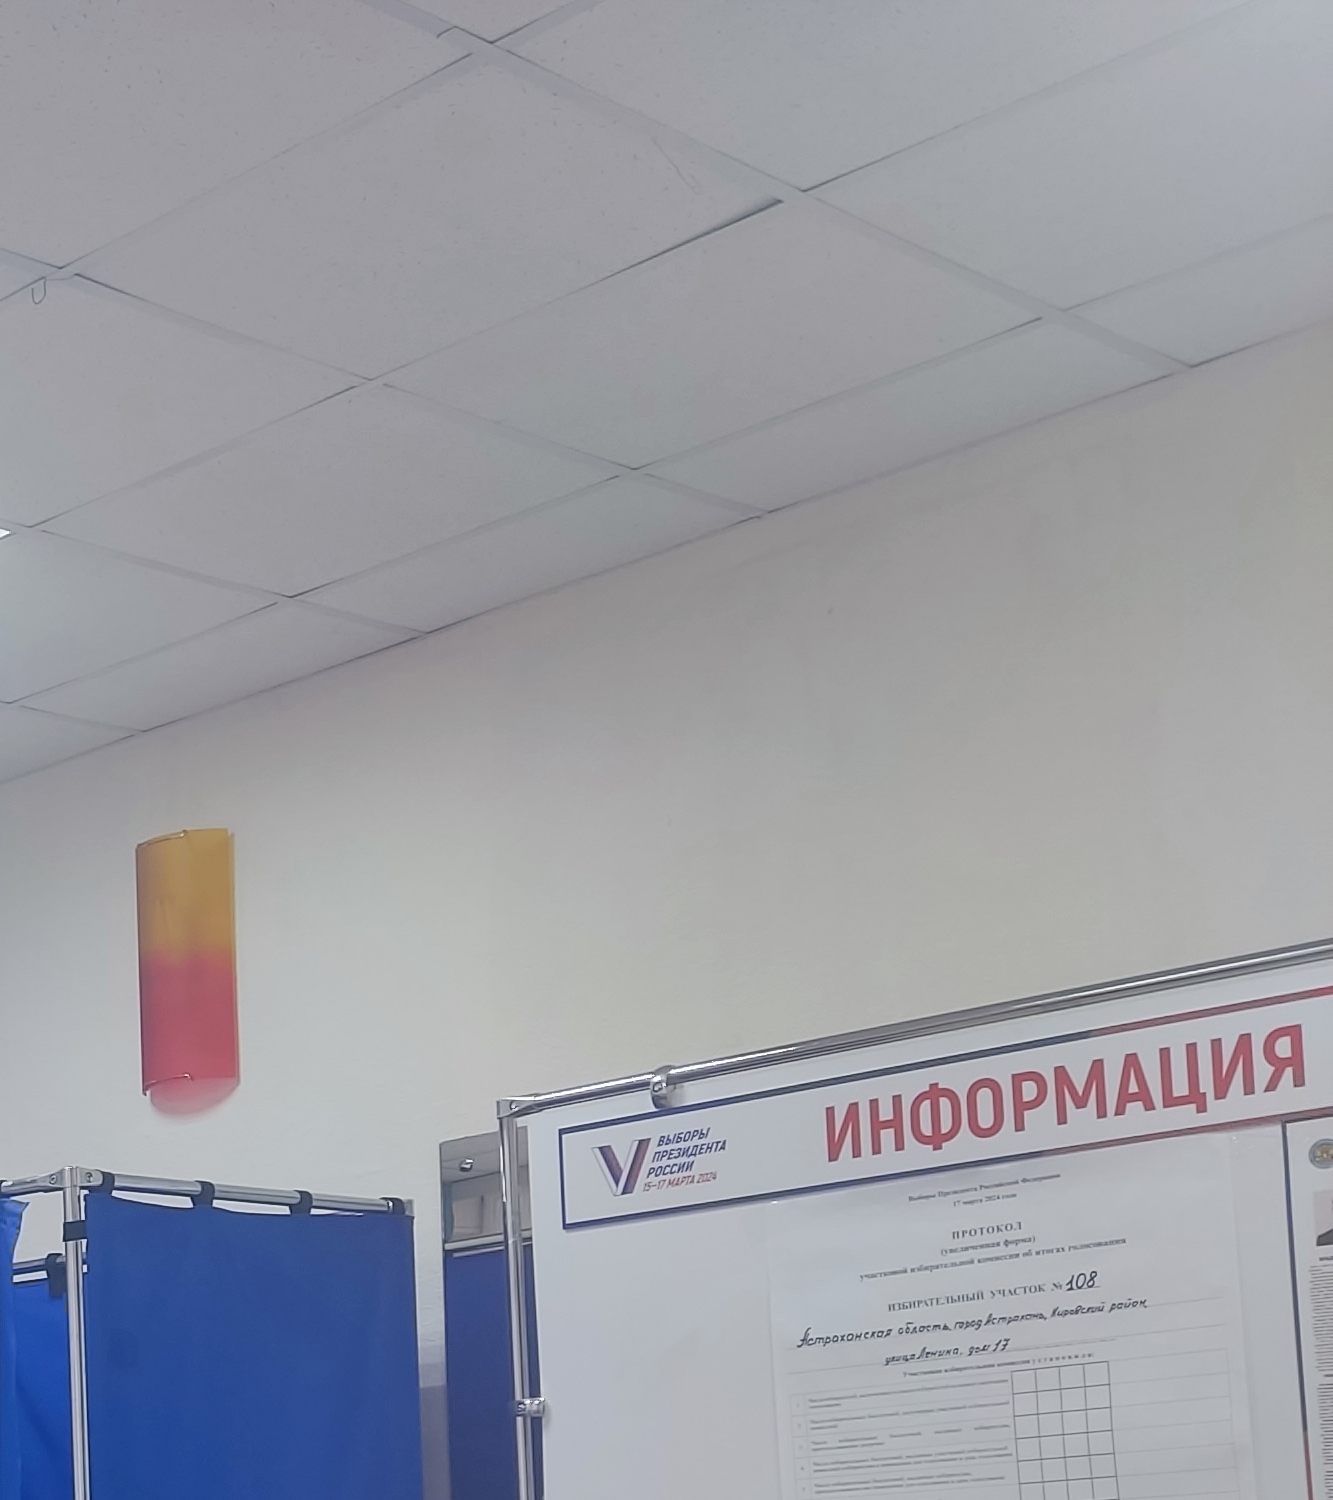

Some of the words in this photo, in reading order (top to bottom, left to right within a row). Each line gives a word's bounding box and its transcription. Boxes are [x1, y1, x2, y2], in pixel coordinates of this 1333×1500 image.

[824, 1023, 1306, 1165] ИНФОРМАЦИЯ
[656, 1127, 711, 1147] ВЫБОРЫ
[651, 1139, 727, 1163] ПРЕЗИДЕНТА
[646, 1160, 695, 1179] РОССИИ
[666, 1175, 695, 1189] МАРТА
[952, 1221, 1022, 1240] ПРОТОКОЛ
[1022, 1249, 1033, 1258] об
[1034, 1246, 1066, 1256] итогах
[888, 1290, 985, 1312] ИЗБИРАТЕЛЬНЫЙ
[990, 1283, 1047, 1300] УЧАСТОК
[1065, 1270, 1098, 1291] 108
[954, 1318, 983, 1331] город
[1050, 1301, 1106, 1318] Кировский
[883, 1352, 916, 1367] улица
[967, 1343, 992, 1357] дом
[992, 1337, 1011, 1352] 17
